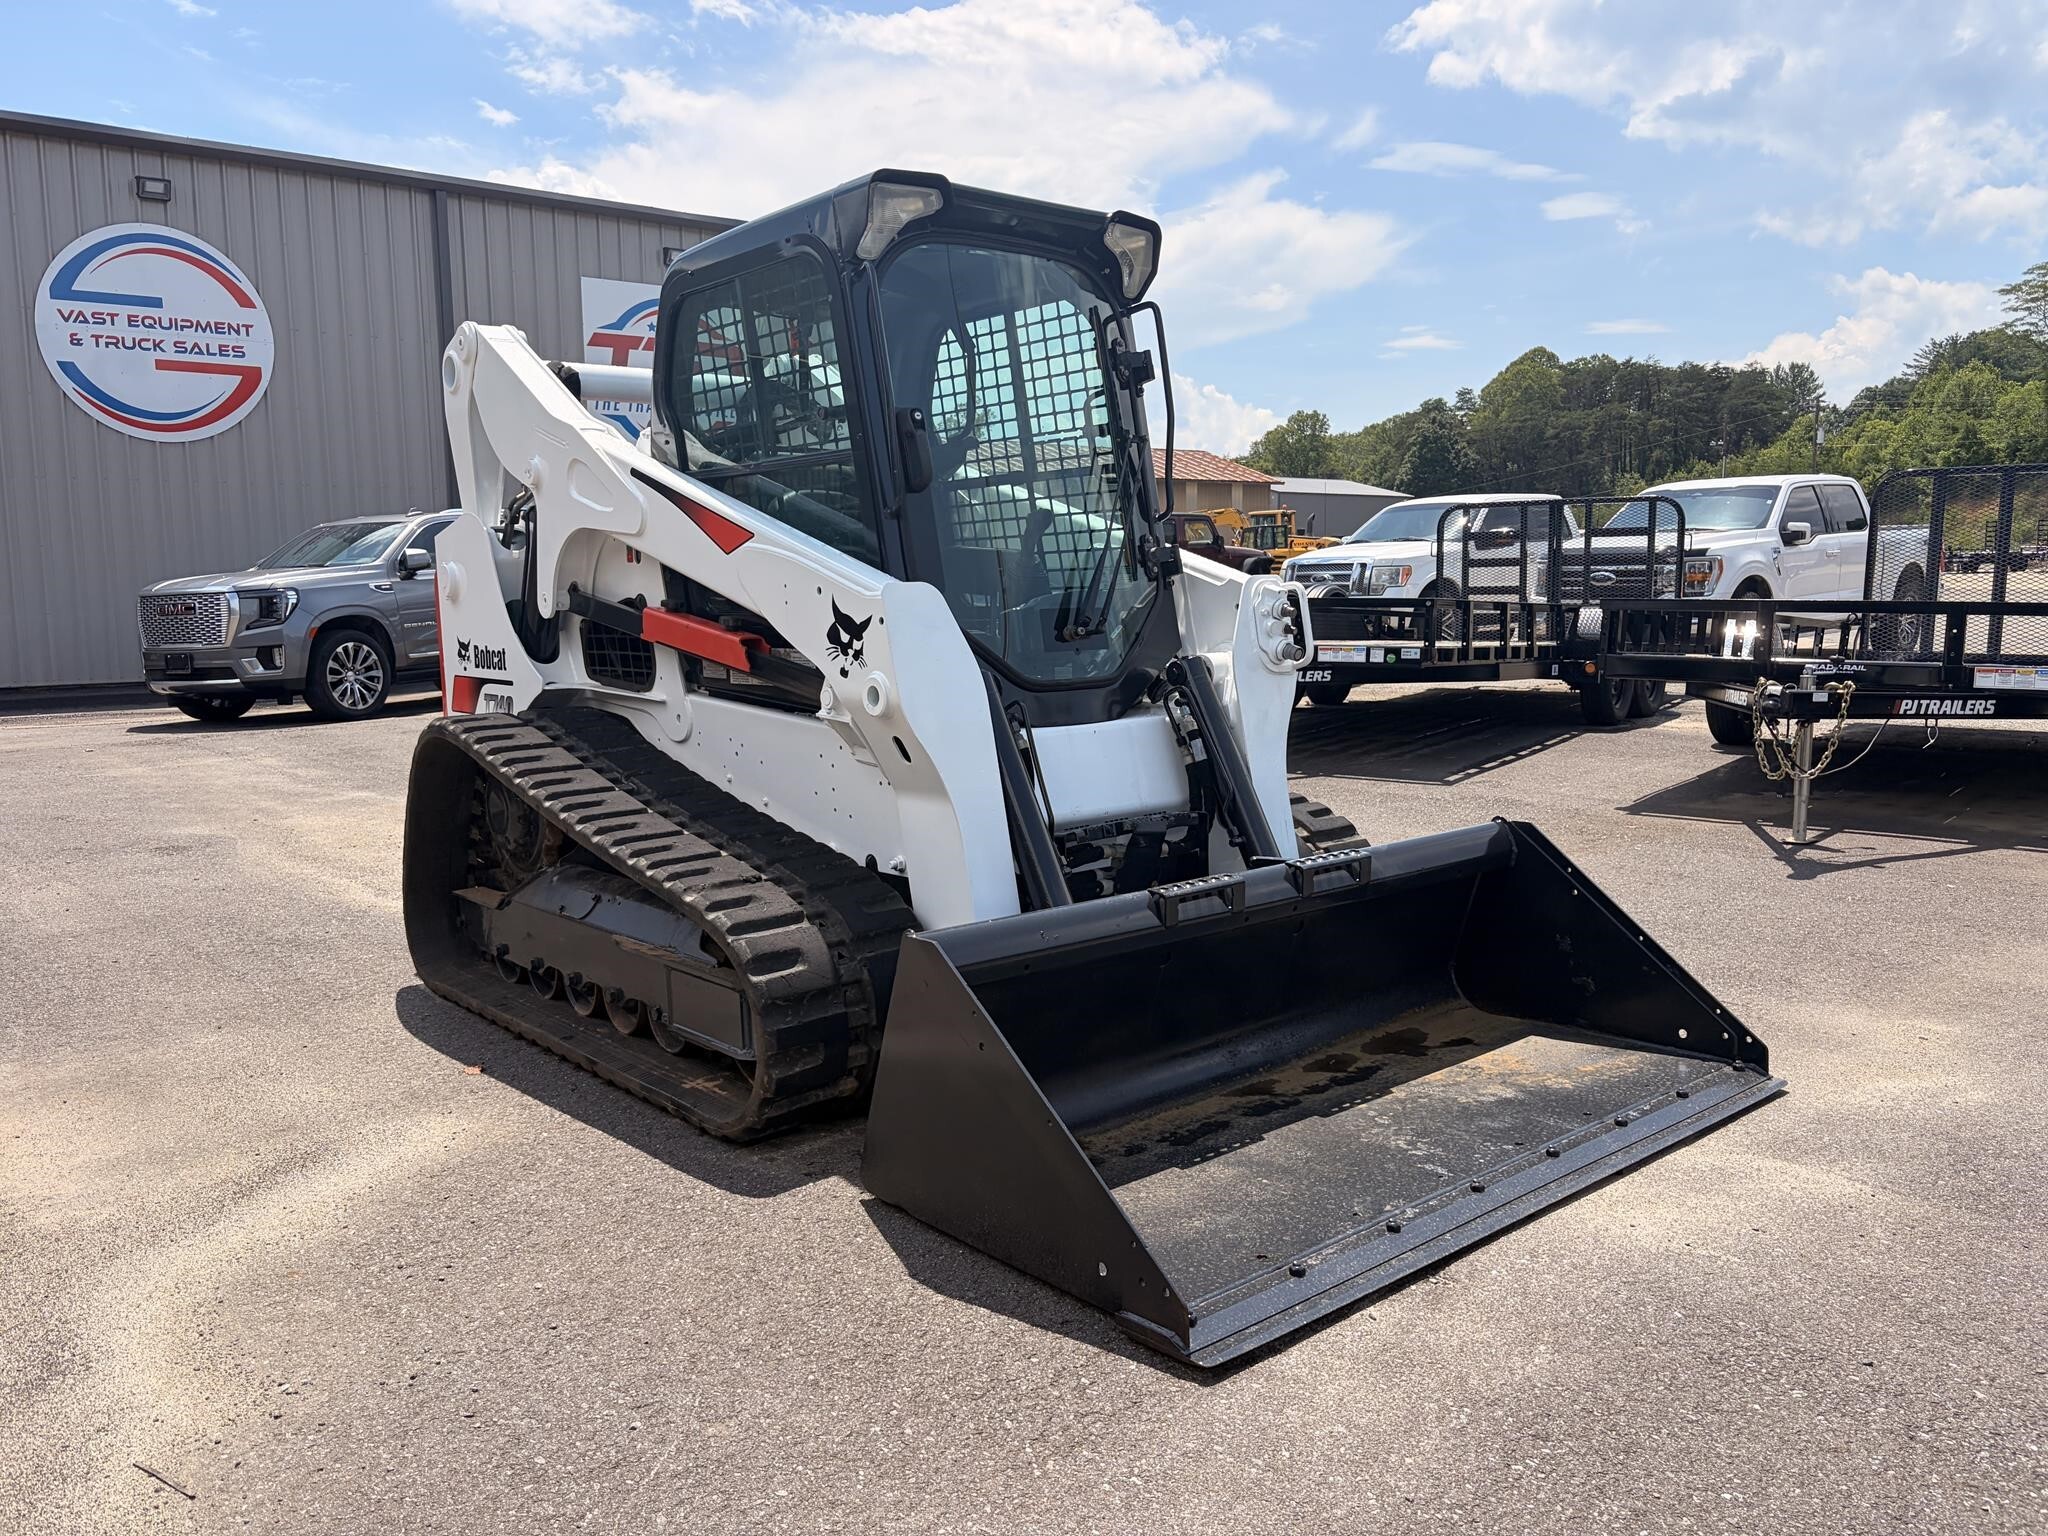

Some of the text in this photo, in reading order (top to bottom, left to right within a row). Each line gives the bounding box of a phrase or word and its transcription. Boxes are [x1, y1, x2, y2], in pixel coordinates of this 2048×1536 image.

[56, 308, 255, 338] VAST EQUIPMENT
[69, 332, 246, 359] & TRUCK SALES
[473, 644, 507, 672] Bobcat
